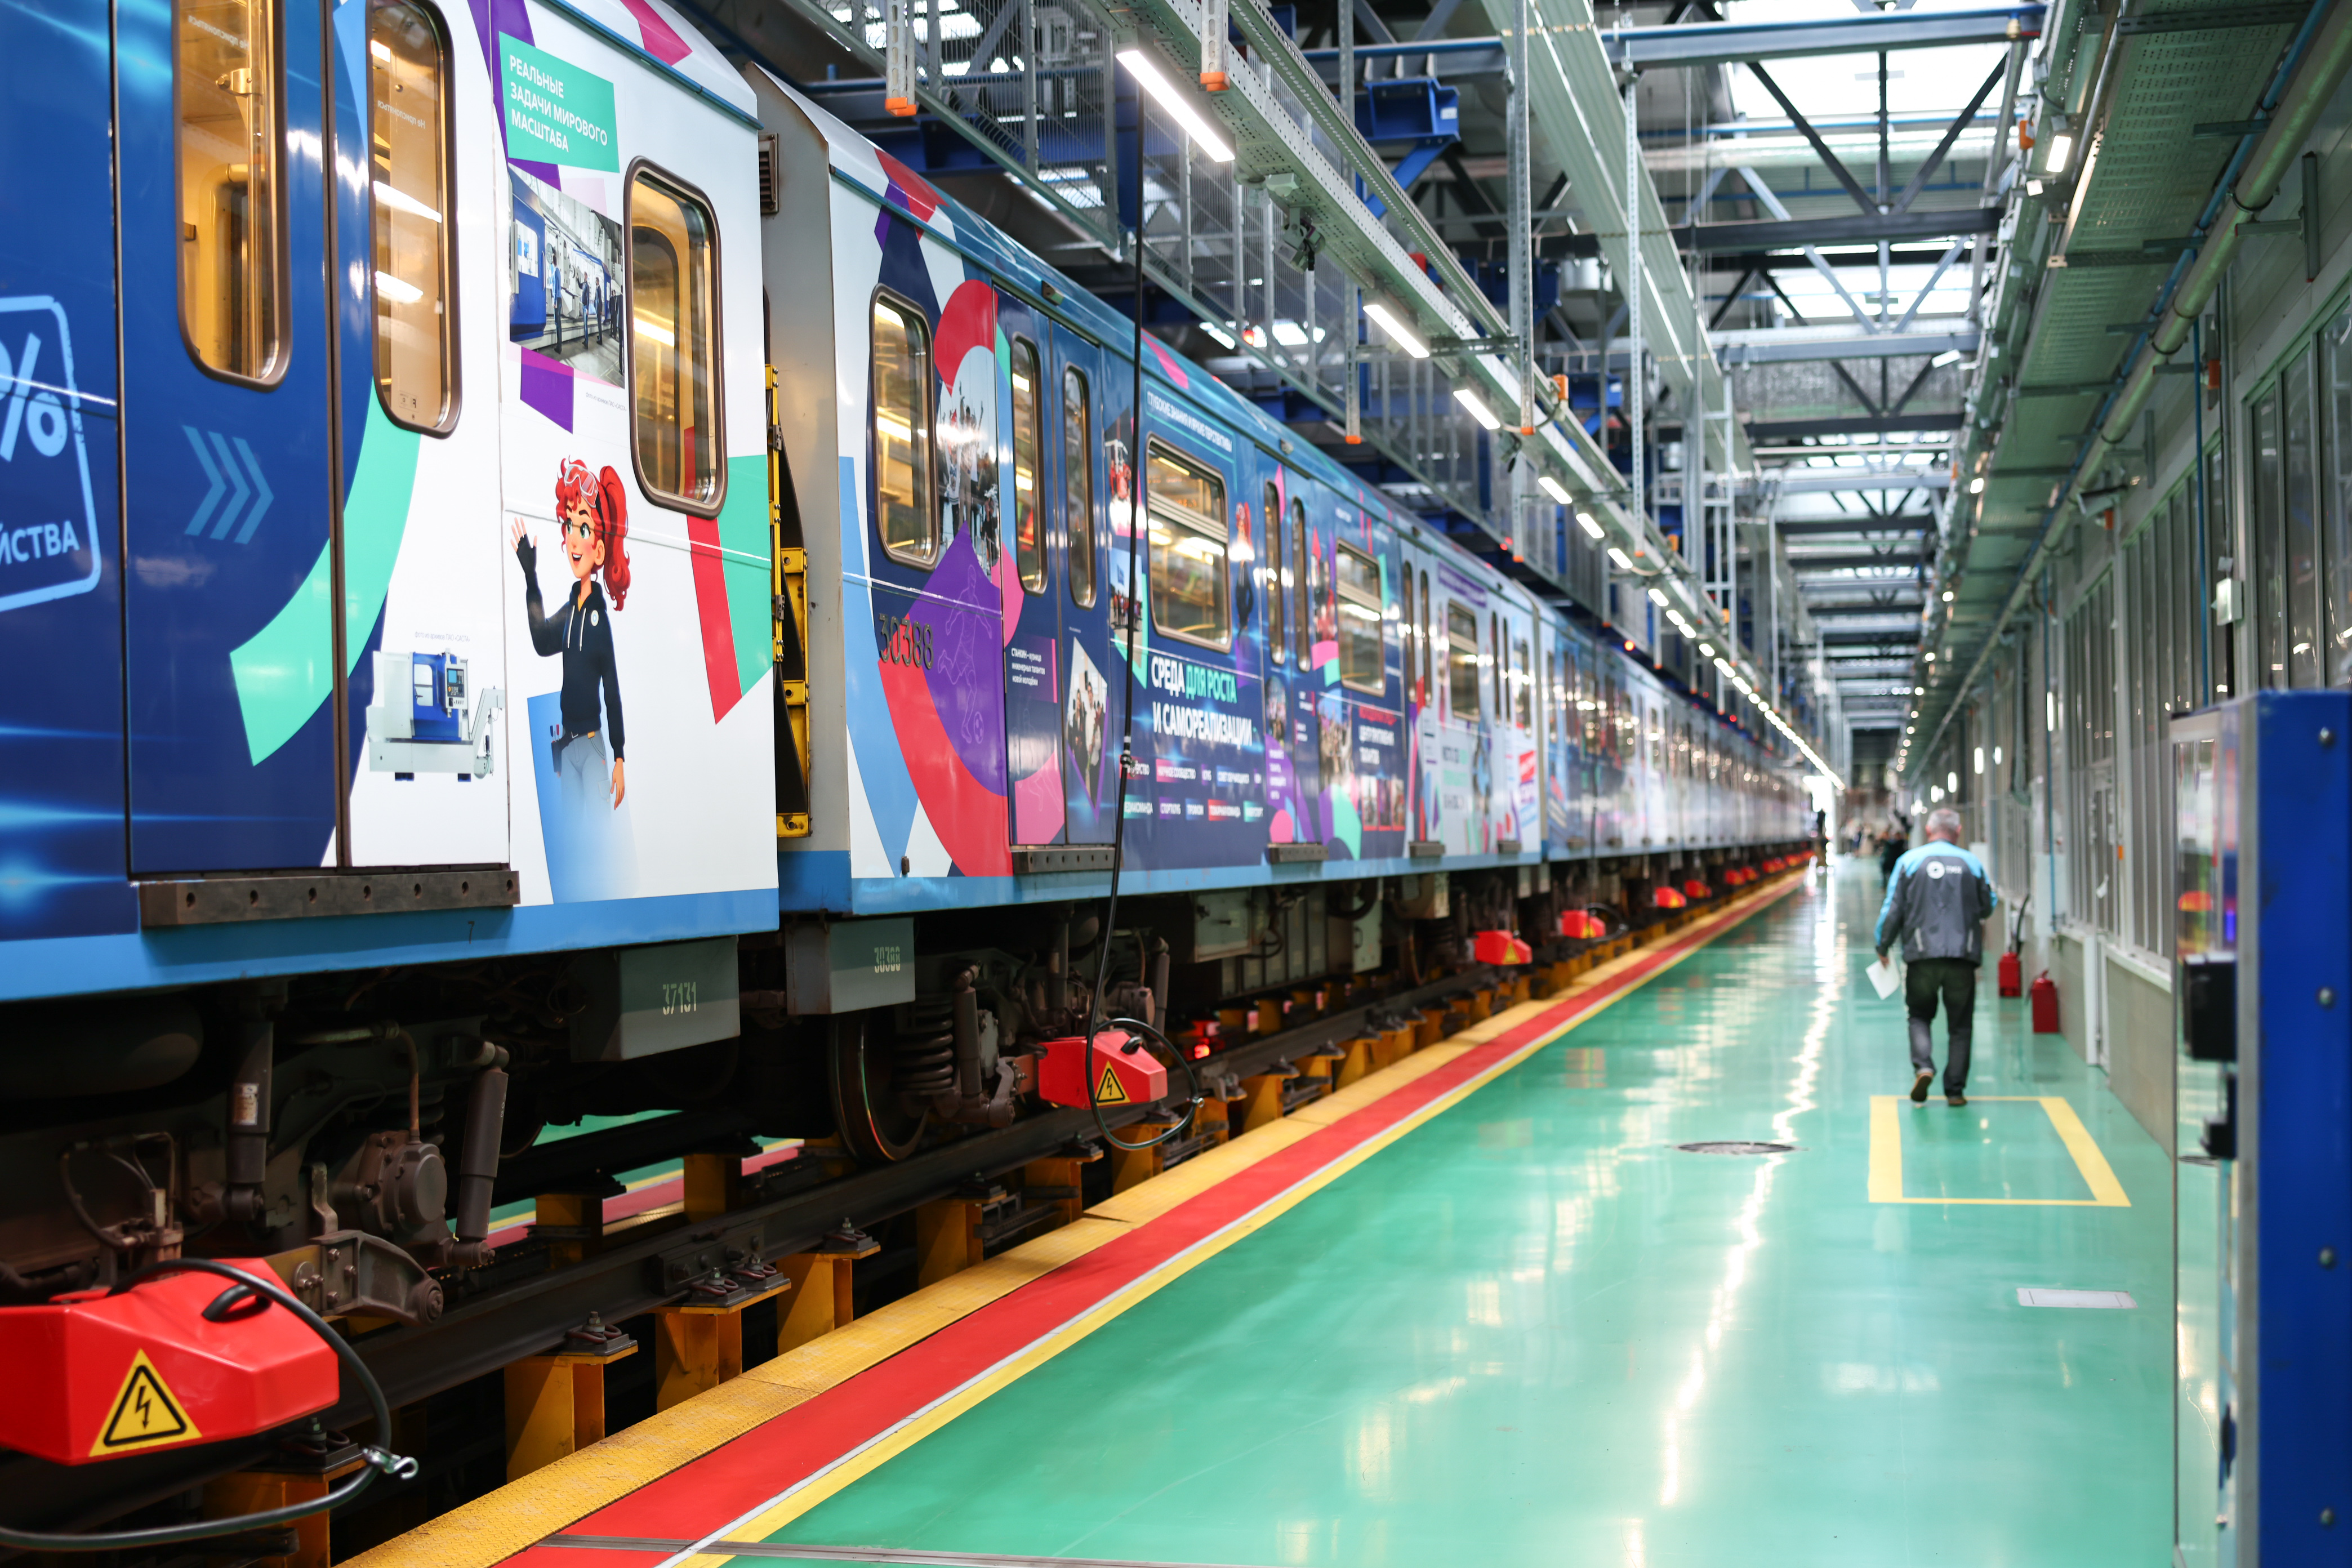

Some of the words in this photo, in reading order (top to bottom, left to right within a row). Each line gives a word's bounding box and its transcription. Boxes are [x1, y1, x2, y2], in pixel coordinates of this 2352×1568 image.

[510, 54, 564, 99] РЕАЛЬНЫЕ
[510, 82, 551, 118] ЗАДАЧИ
[553, 104, 608, 146] МИРОВОГО
[511, 108, 569, 153] МАСШТАБА
[879, 613, 933, 670] 30388
[1151, 656, 1185, 697] СРЕДА
[1186, 664, 1206, 700] ДЛЯ
[1207, 669, 1237, 704] РОСТА
[1152, 701, 1162, 733] И
[1162, 703, 1253, 750] САМОРЕАЛИЗАЦИИ
[874, 946, 901, 973] 30388
[662, 982, 697, 1015] 37131
